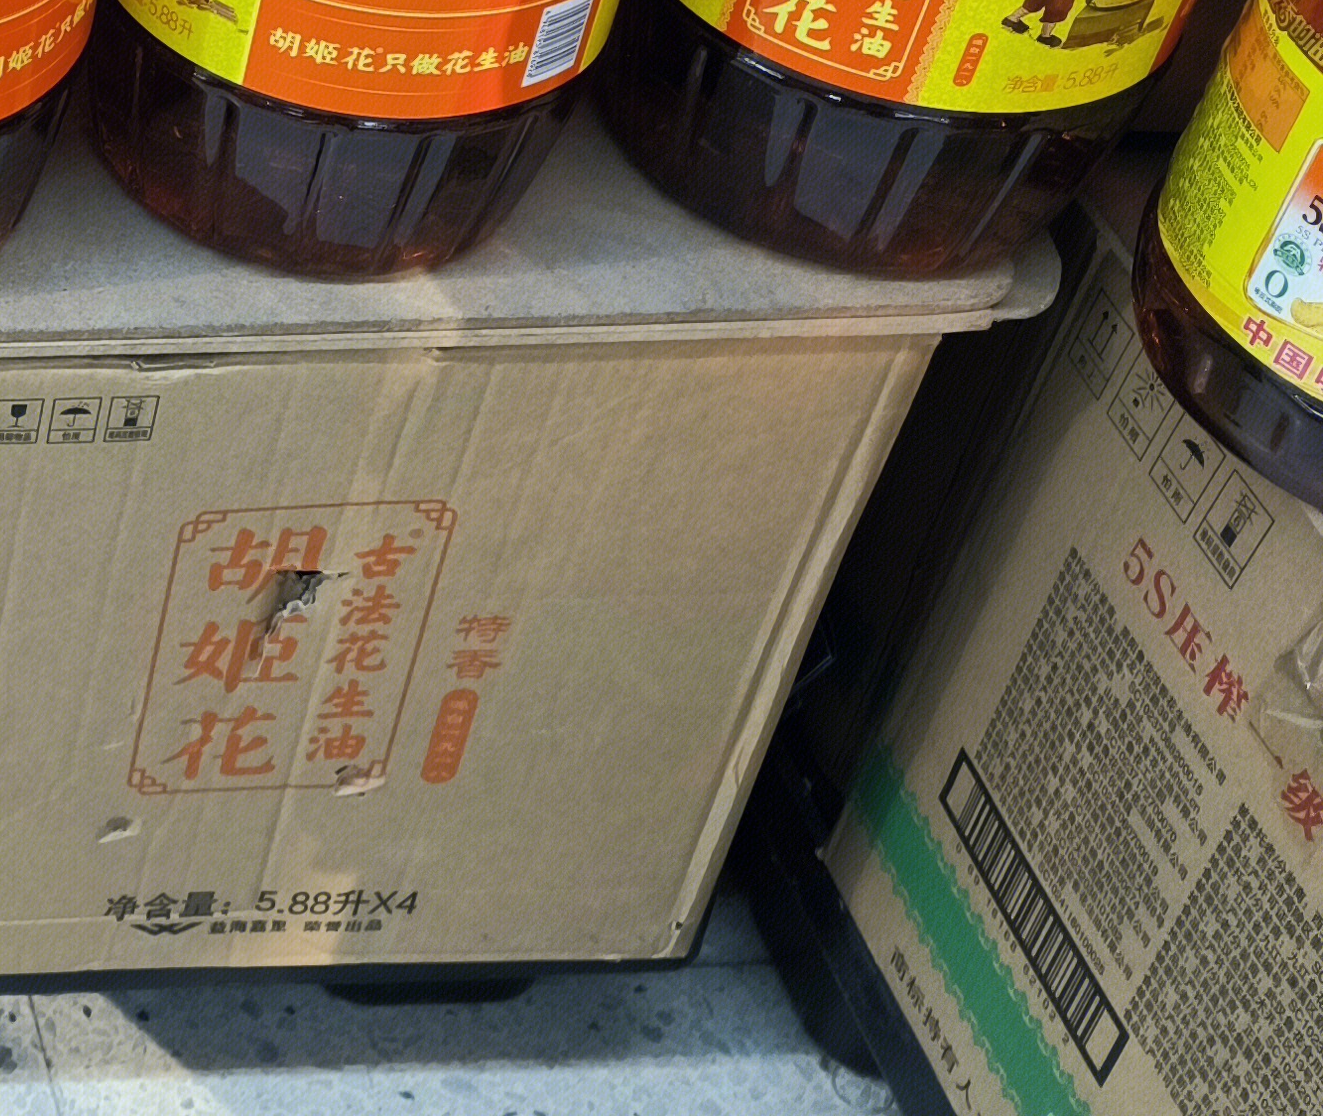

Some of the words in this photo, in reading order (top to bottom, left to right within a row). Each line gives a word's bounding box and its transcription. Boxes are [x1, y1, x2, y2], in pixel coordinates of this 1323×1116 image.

[268, 25, 531, 79] 胡姬花只做花生油
[161, 525, 329, 782] 胡姬花
[304, 533, 418, 763] 古法花生油
[445, 614, 512, 680] 特香
